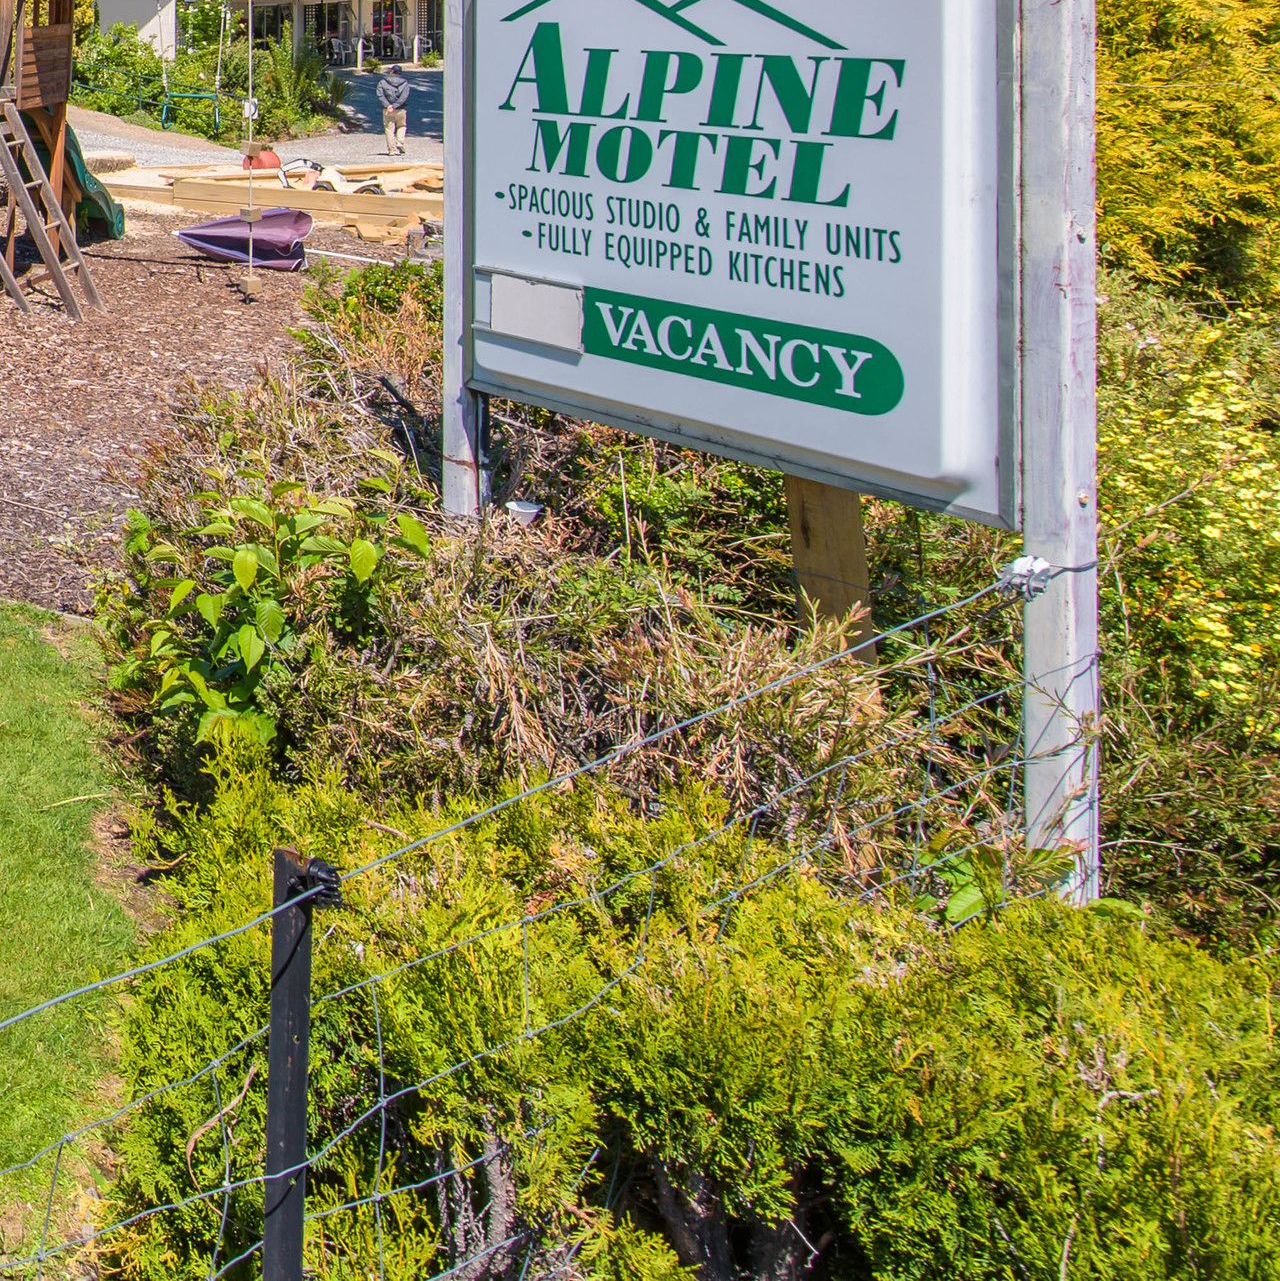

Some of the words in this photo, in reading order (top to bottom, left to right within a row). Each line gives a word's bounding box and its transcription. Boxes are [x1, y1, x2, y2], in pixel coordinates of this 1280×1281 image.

[498, 21, 906, 140] ALPINE
[525, 118, 851, 208] MOTEL
[508, 183, 594, 221] SPACIOUS
[606, 195, 680, 233] STUDIO
[695, 207, 710, 238] &
[726, 210, 808, 251] FAMILY
[826, 222, 902, 264] UNITS
[537, 221, 592, 257] FULLY
[605, 232, 713, 276] EQUIPPED
[728, 250, 845, 298] KITCHENS
[595, 301, 872, 399] VACANCY
